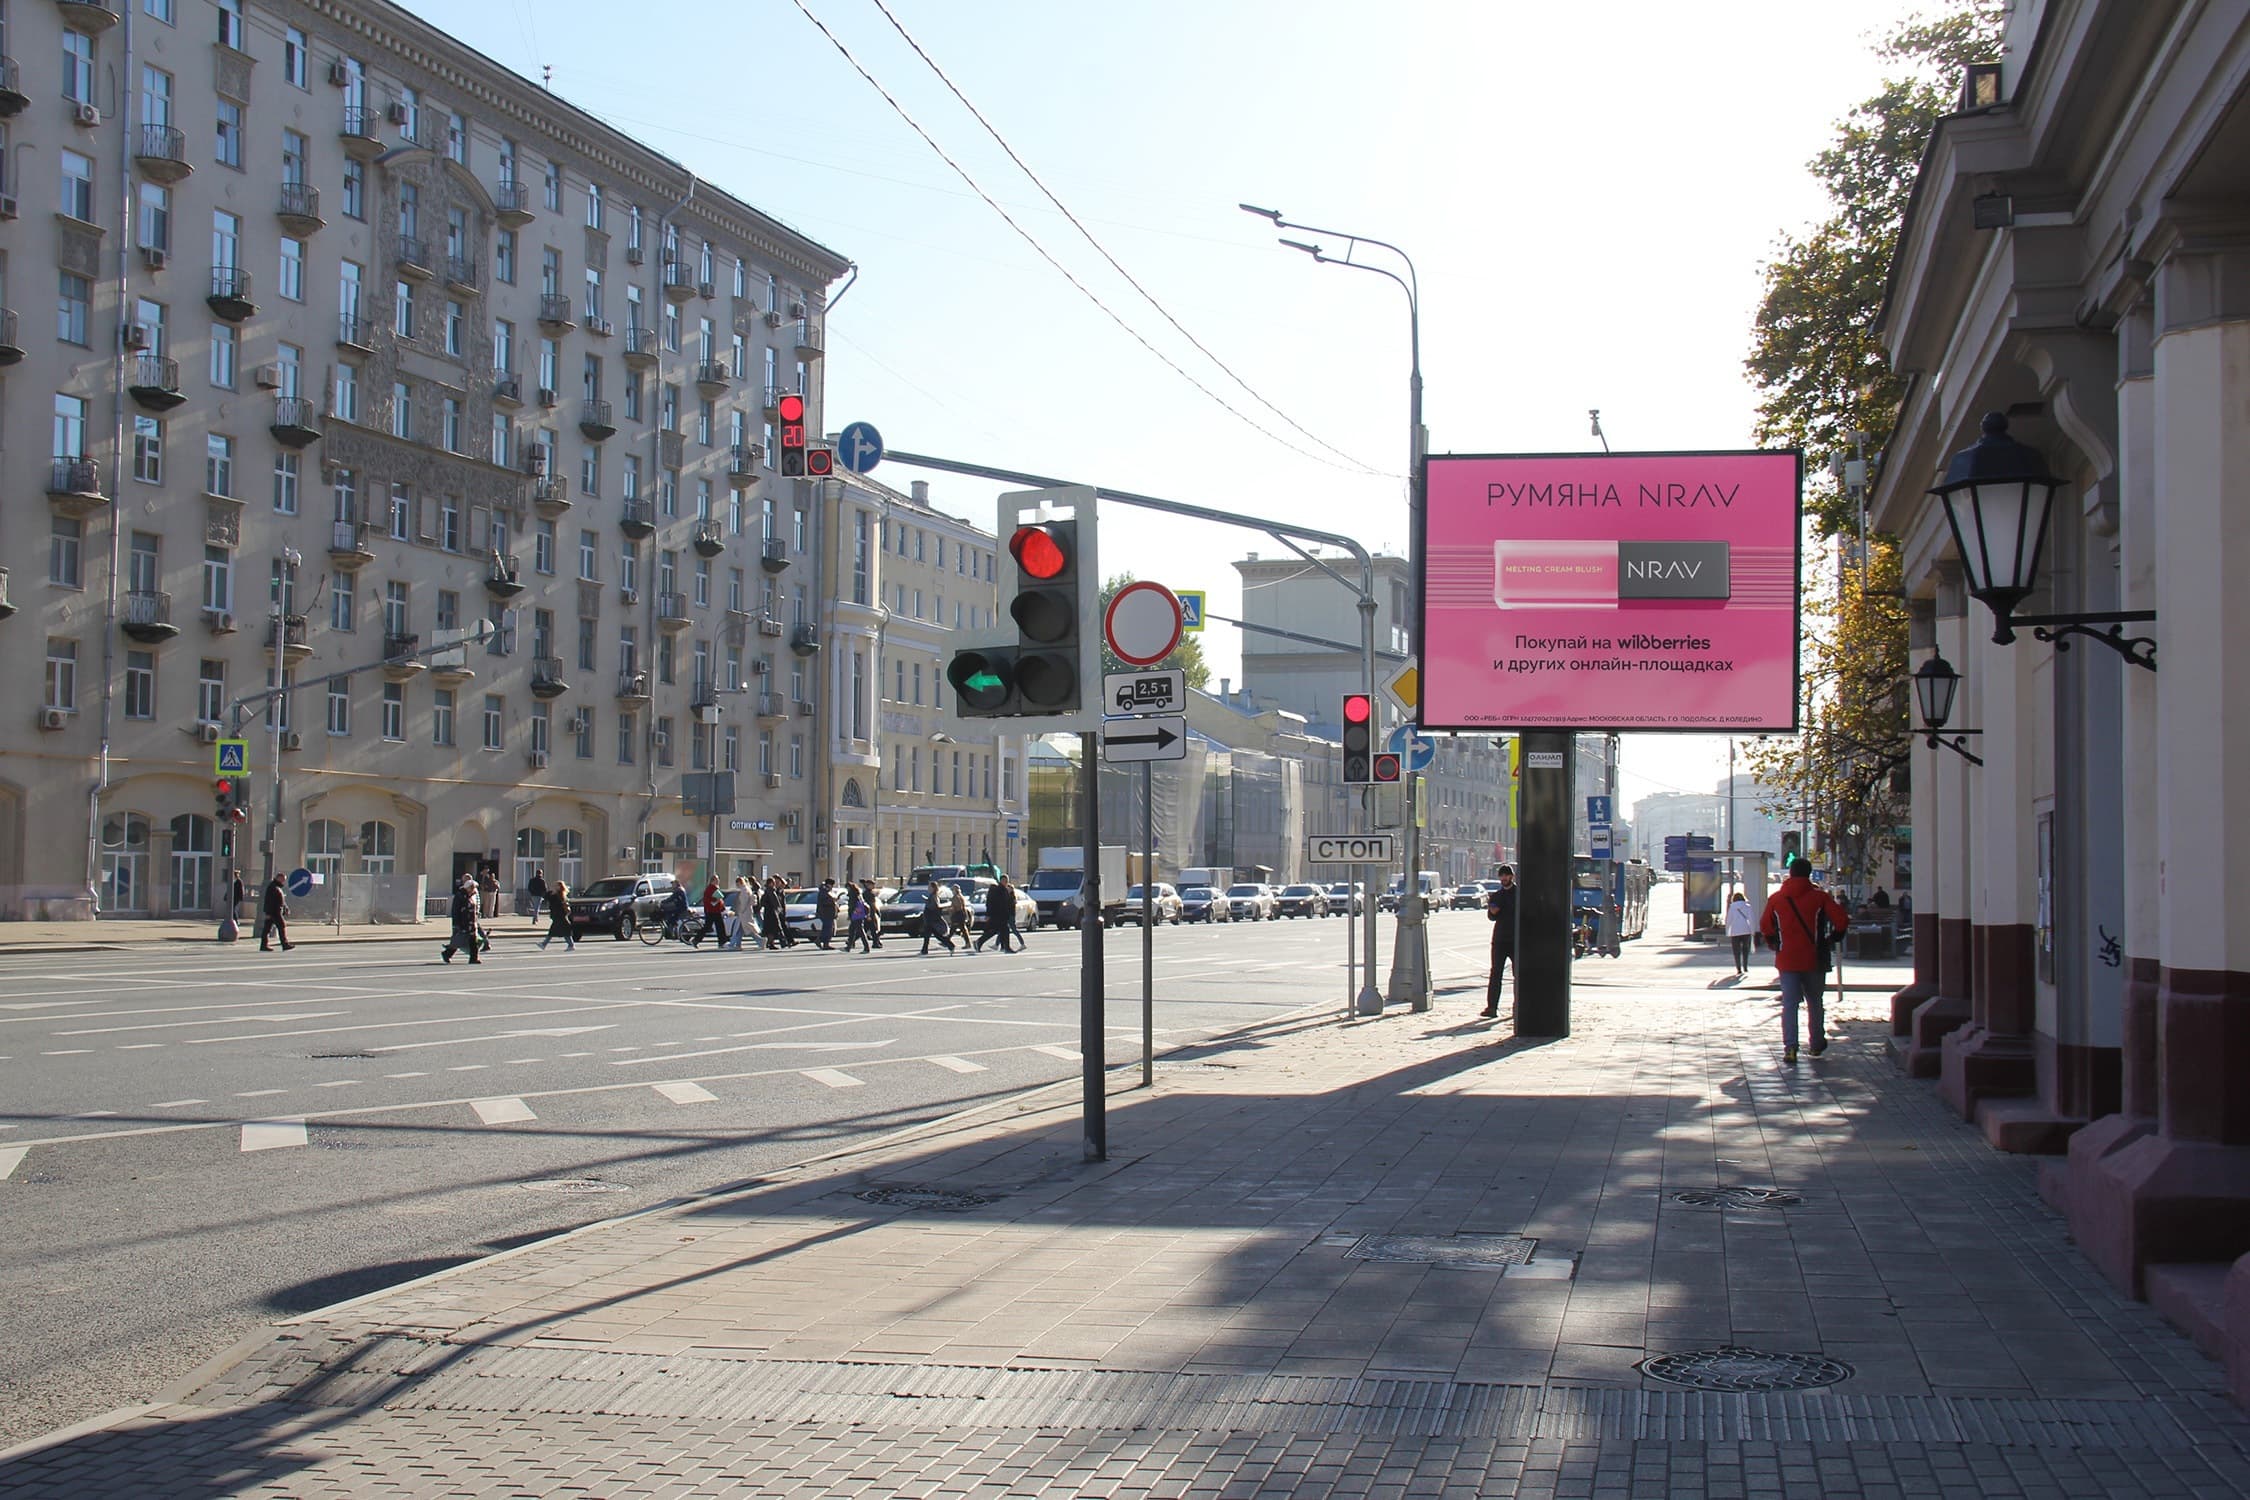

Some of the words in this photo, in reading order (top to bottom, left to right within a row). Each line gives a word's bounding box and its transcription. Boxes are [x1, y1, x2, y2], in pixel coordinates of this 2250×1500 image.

[783, 425, 803, 447] 20
[1488, 483, 1622, 507] РУМЯНА
[1639, 483, 1740, 508] NRAV
[1505, 565, 1542, 574] MELTING
[1545, 565, 1573, 574] CREAM
[1575, 565, 1603, 574] BLUSH
[1627, 560, 1702, 579] NRAV
[1515, 634, 1587, 652] Покупай
[1592, 639, 1612, 650] на
[1617, 634, 1711, 650] wildberries
[1493, 660, 1504, 671] и
[1507, 658, 1566, 674] других
[1569, 657, 1734, 673] онлайн-площадках
[1139, 682, 1159, 696] 2,5
[1318, 840, 1383, 858] СТОП
